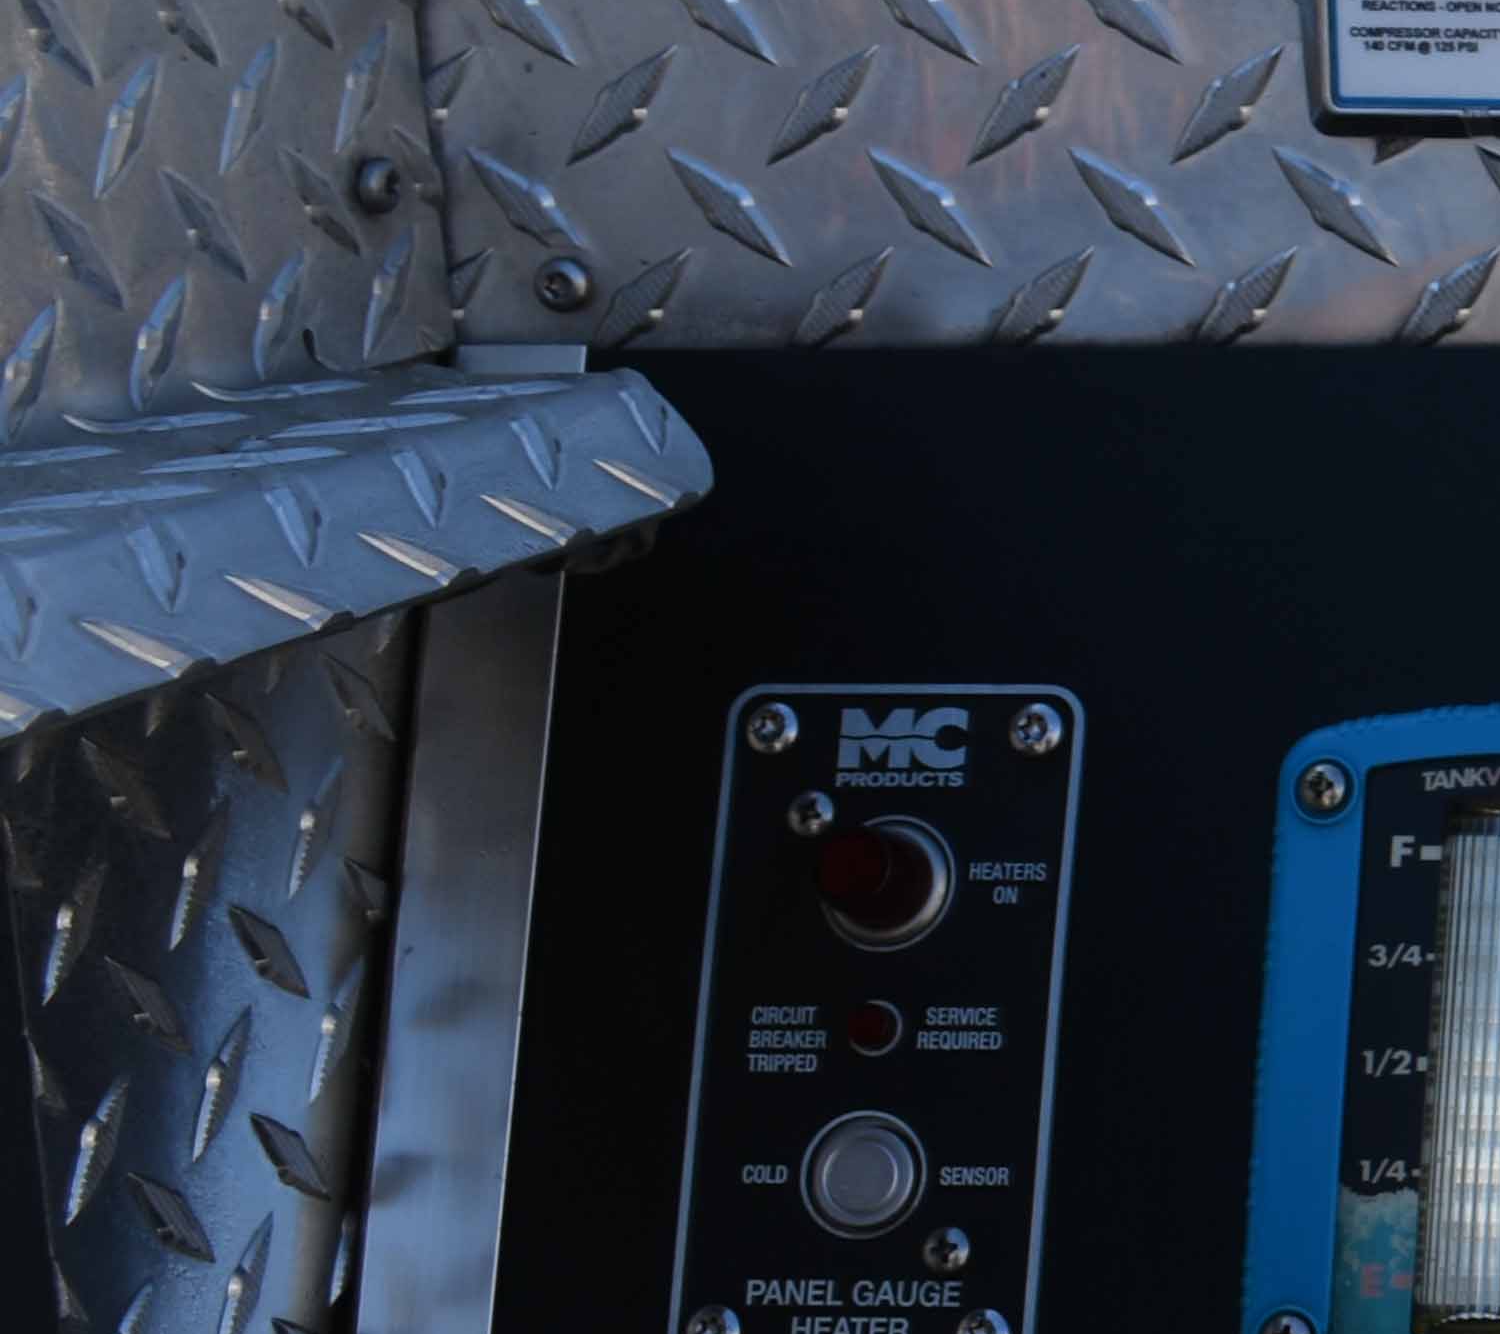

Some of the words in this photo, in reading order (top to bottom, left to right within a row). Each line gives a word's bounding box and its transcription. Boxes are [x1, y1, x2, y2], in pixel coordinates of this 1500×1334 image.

[837, 707, 968, 768] MC
[835, 767, 964, 787] PRODUCTS
[1390, 835, 1415, 867] F
[969, 862, 1047, 881] HEATERS
[992, 886, 1018, 904] ON
[1368, 943, 1422, 968] 3/4
[750, 1006, 817, 1025] CIRCUIT
[926, 1007, 997, 1026] SERVICE
[748, 1030, 826, 1049] BREAKER
[916, 1031, 1002, 1050] REQUIRED
[747, 1054, 818, 1072] TRIPPED
[1363, 1048, 1411, 1077] 1/2
[742, 1165, 788, 1184] COLD
[940, 1166, 1009, 1186] SENSOR
[1360, 1158, 1406, 1184] 1/4
[746, 1279, 843, 1306] PANEL
[852, 1280, 962, 1307] GAUGE
